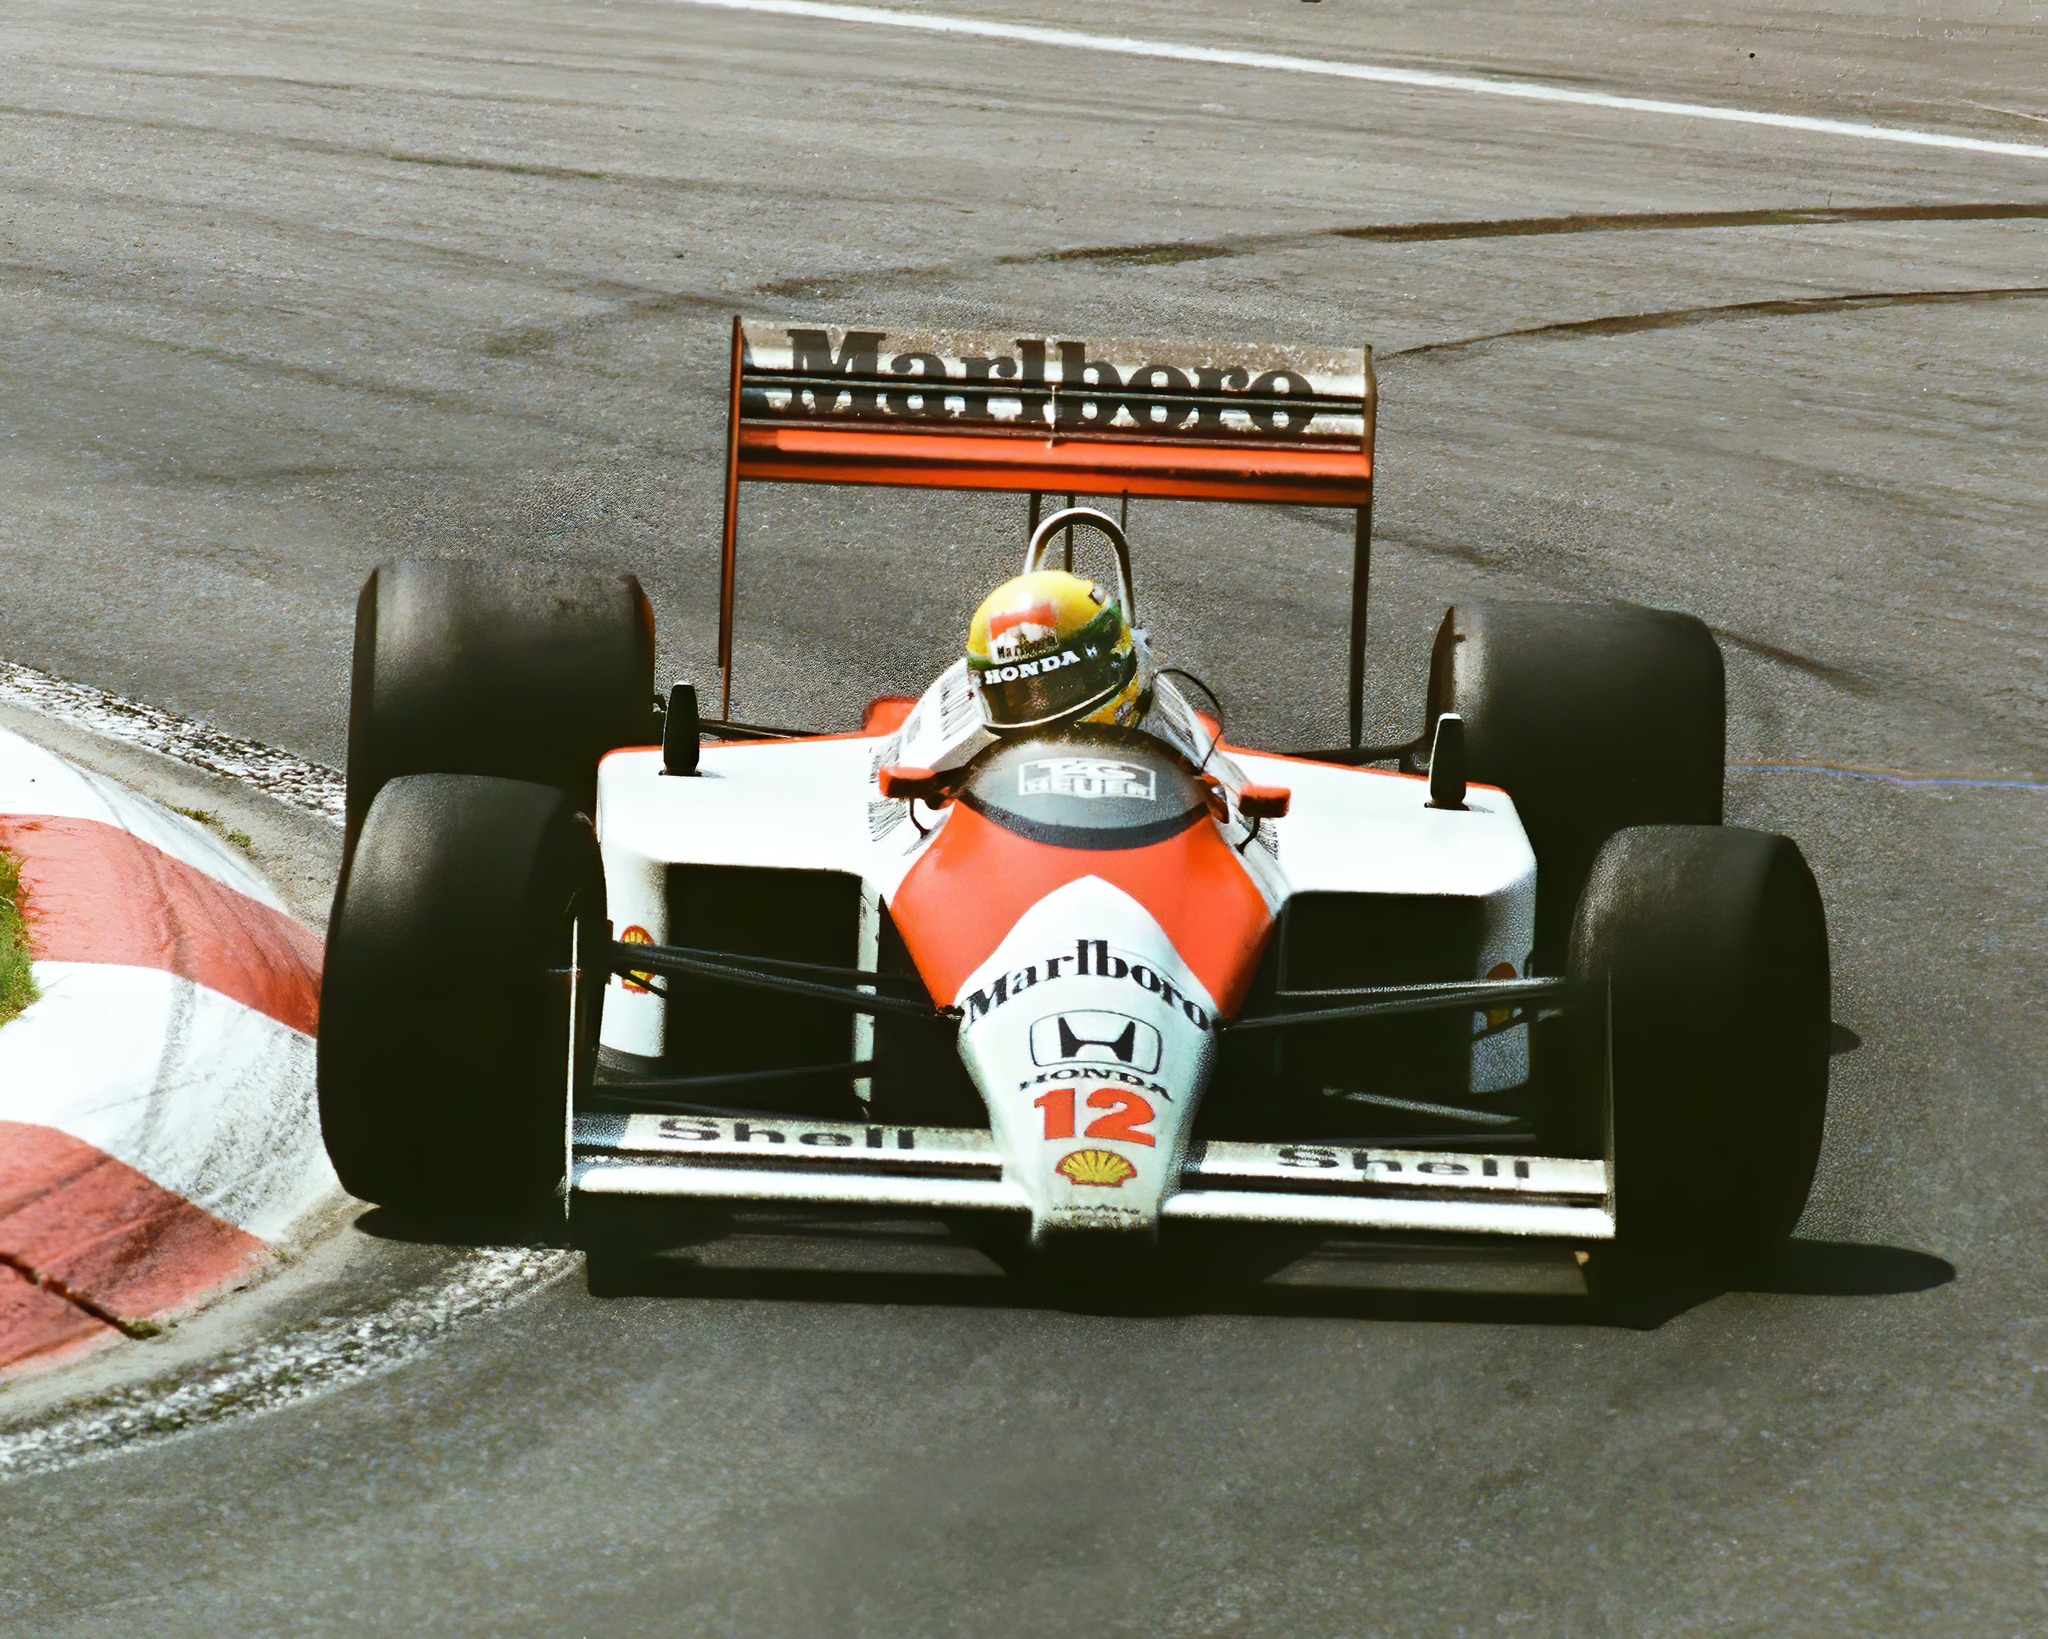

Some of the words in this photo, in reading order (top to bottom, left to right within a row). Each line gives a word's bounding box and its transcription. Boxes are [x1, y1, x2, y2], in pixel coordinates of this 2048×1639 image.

[786, 328, 1317, 431] Marlboro
[984, 650, 1080, 685] HONDA
[967, 939, 1210, 1031] Marlboro
[659, 1117, 915, 1150] Shell
[1034, 1088, 1156, 1148] 12
[1277, 1147, 1530, 1180] Shell
